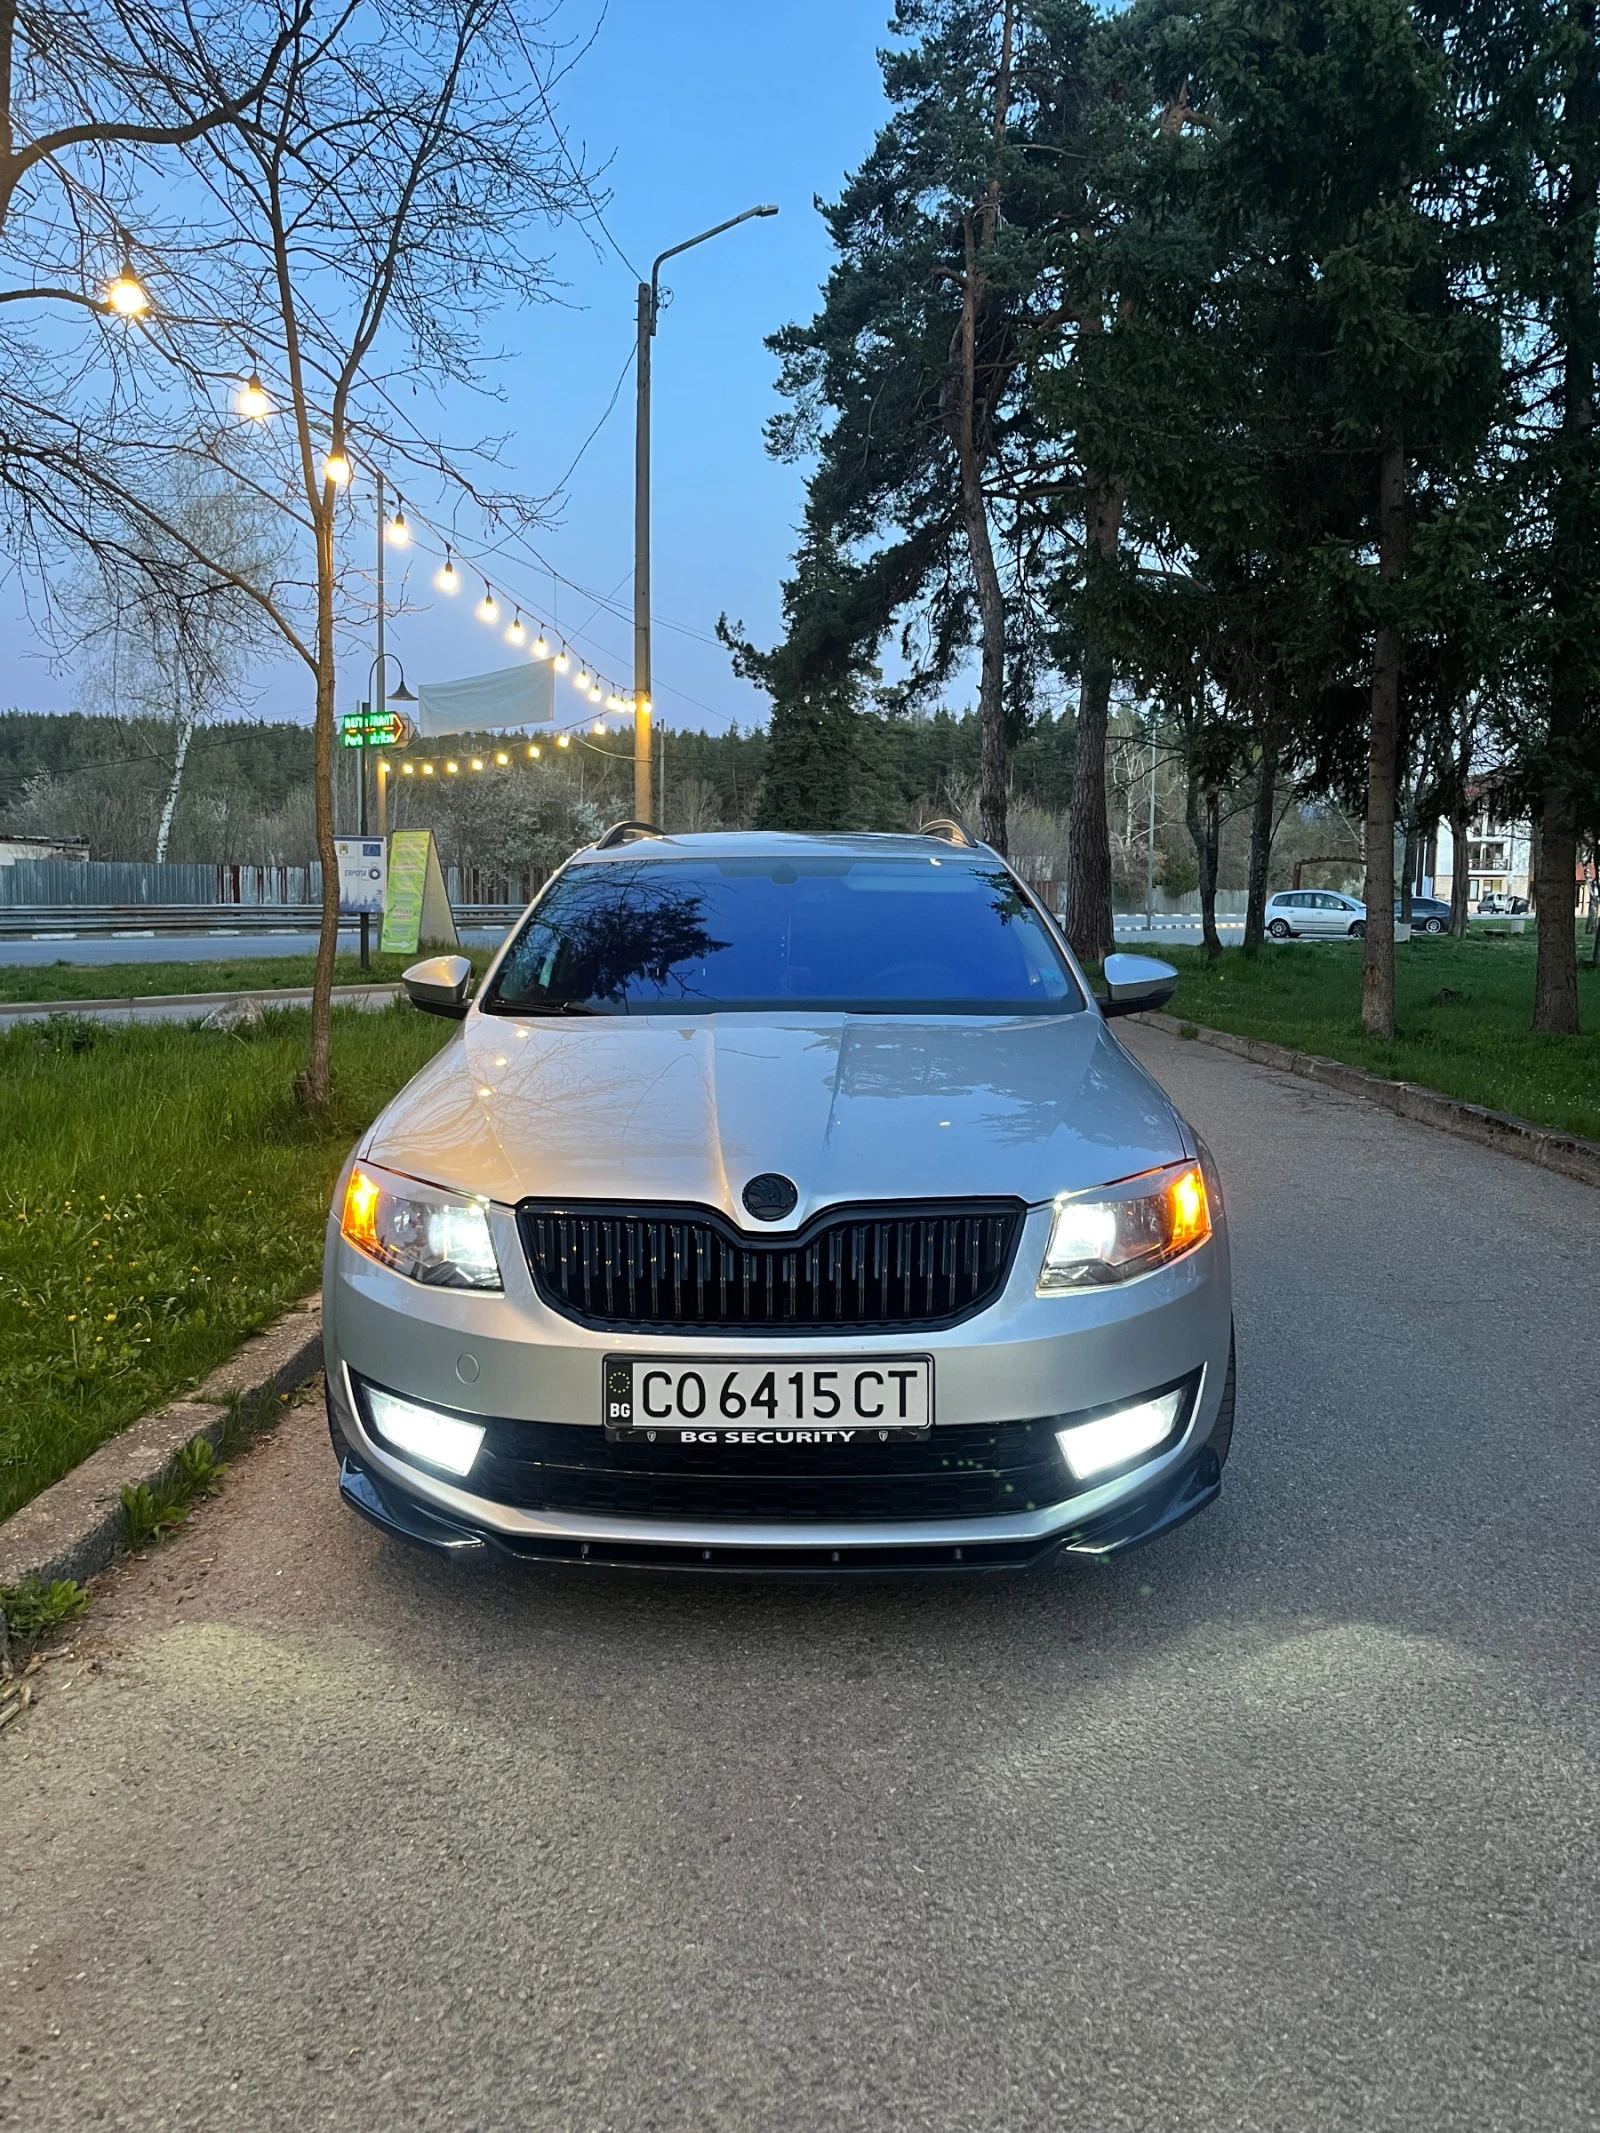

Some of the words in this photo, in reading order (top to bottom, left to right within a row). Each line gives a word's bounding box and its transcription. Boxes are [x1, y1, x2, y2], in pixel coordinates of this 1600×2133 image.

[642, 1371, 706, 1418] CO
[719, 1371, 841, 1418] 6415
[854, 1370, 918, 1418] CT
[609, 1403, 631, 1418] BG
[680, 1431, 718, 1443] BG
[725, 1431, 856, 1443] SECURITY
